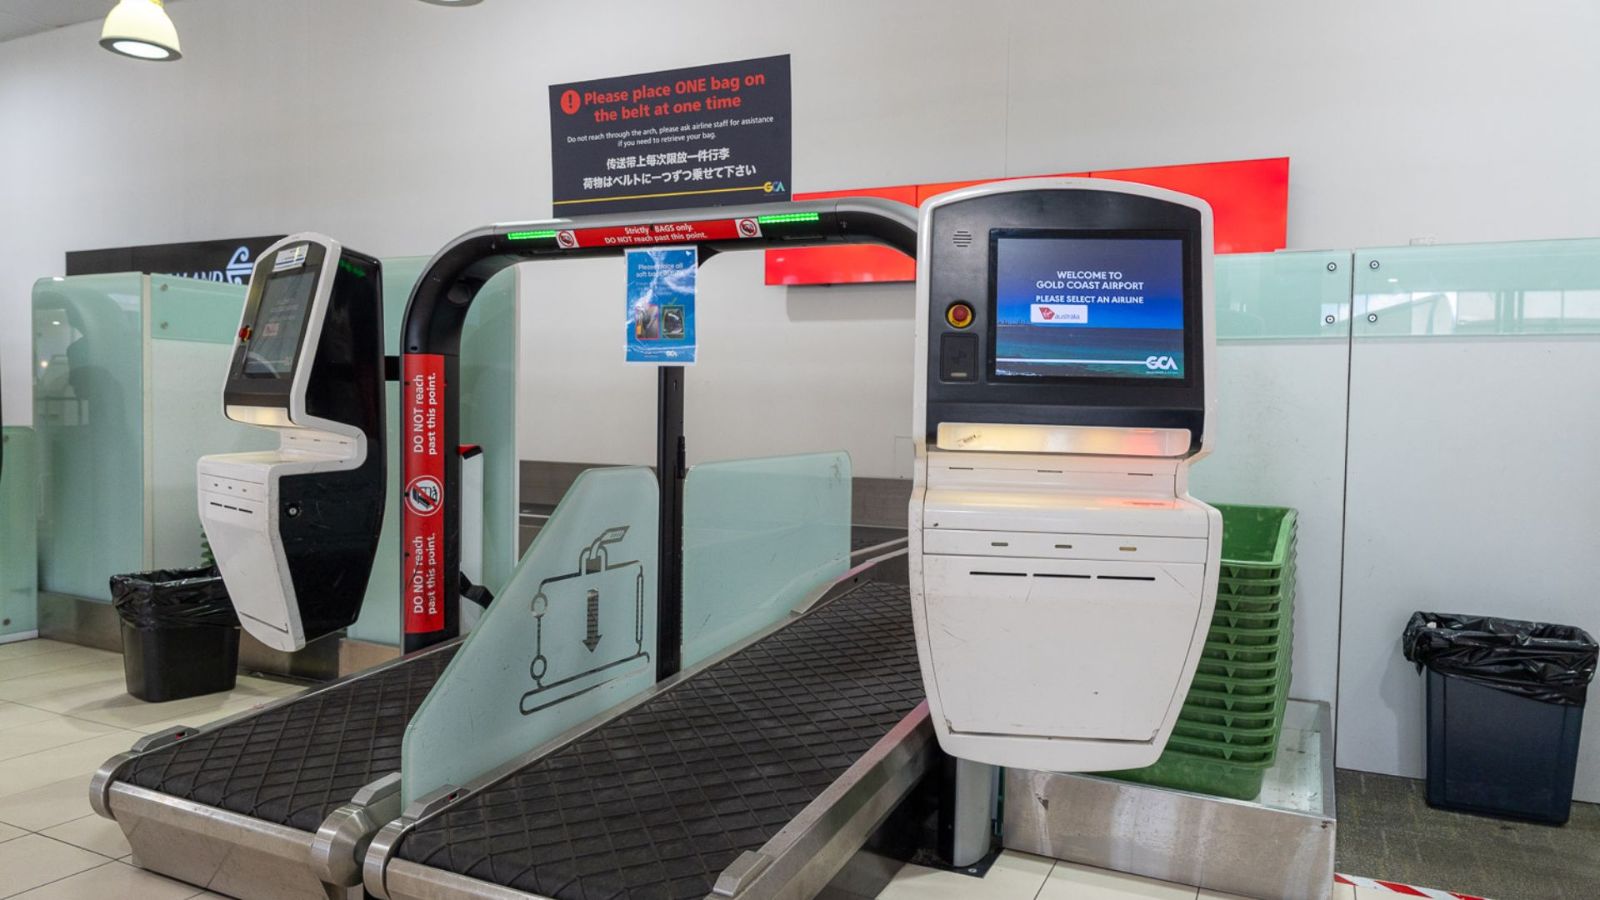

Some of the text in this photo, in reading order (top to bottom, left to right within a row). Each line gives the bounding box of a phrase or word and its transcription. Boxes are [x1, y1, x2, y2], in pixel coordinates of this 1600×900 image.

[584, 73, 766, 105] Please place ONE bag on
[594, 95, 742, 122] the belt at one time
[588, 133, 605, 141] reach
[606, 130, 630, 140] through
[642, 128, 658, 136] arch,
[659, 126, 679, 135] please
[680, 124, 691, 132] ask
[692, 122, 712, 130] airline
[713, 120, 728, 128] staff
[730, 118, 740, 126] for
[741, 116, 774, 126] assistance
[623, 139, 635, 148] you
[636, 137, 651, 145] need
[661, 133, 685, 143] retrieve
[686, 134, 701, 142] your
[702, 132, 716, 141] bag.
[625, 226, 650, 235] Strictly
[676, 223, 694, 232] only.
[654, 234, 670, 242] past
[686, 232, 707, 240] point.
[1036, 280, 1144, 290] GOLD COAST AIRPORT
[1056, 270, 1123, 280] WELCOME TO
[1036, 295, 1065, 303] PLEASE
[1066, 295, 1096, 303] SELECT
[1111, 296, 1144, 304] AIRLINE
[1146, 355, 1178, 370] GCA
[413, 374, 424, 453] DO NOT reach
[426, 373, 437, 455] past this point.
[412, 536, 424, 614] DO NOT reach
[426, 533, 437, 615] past this point.
